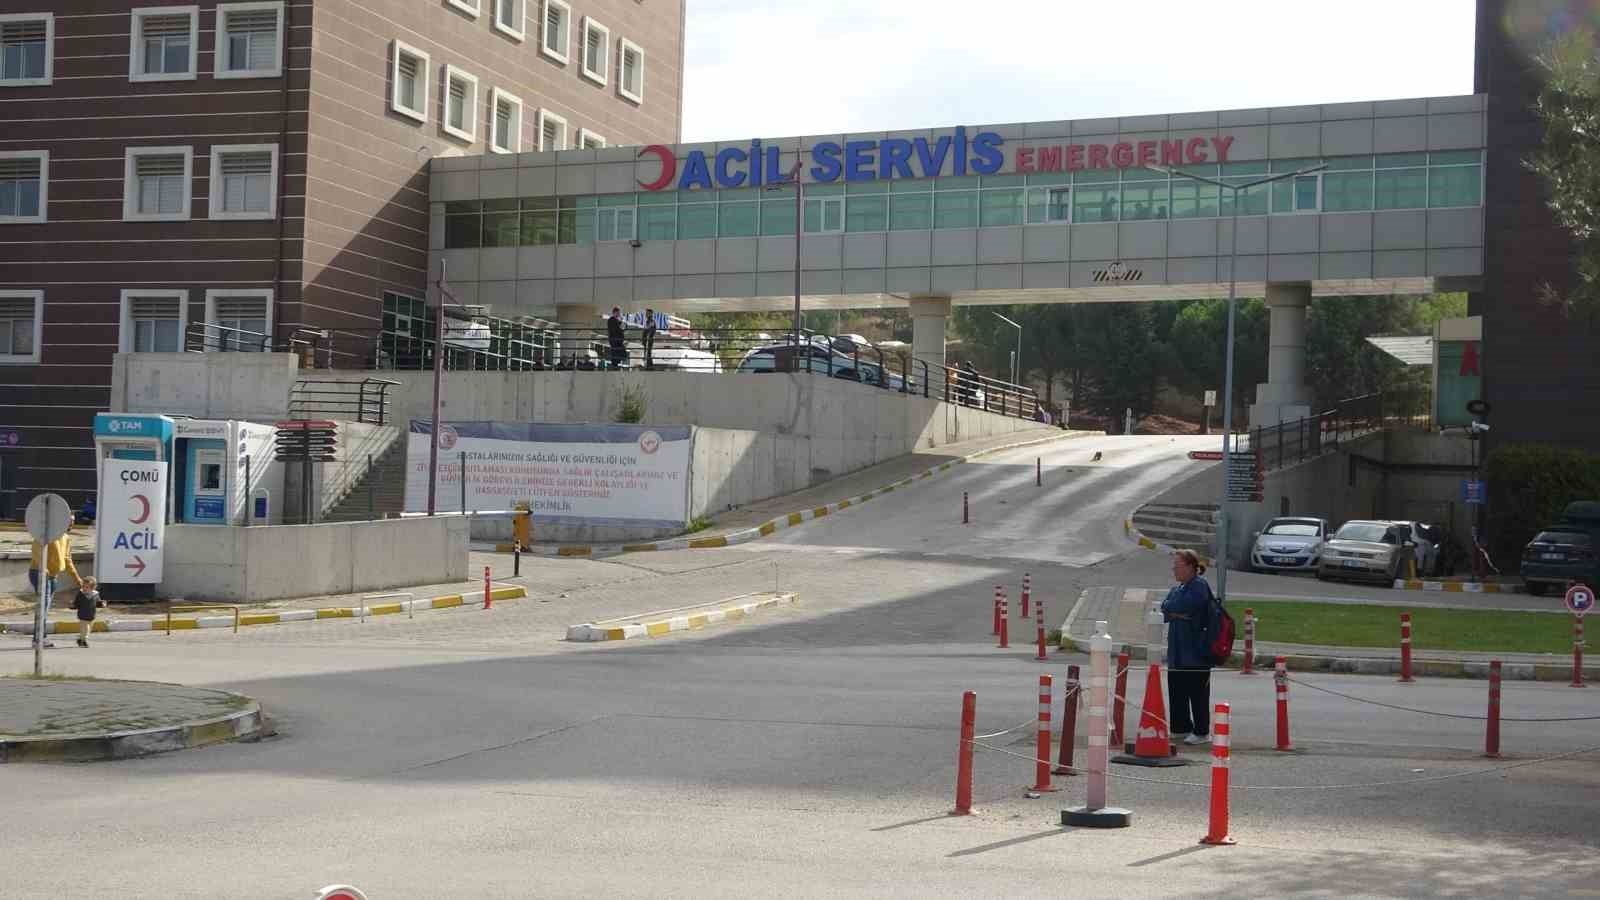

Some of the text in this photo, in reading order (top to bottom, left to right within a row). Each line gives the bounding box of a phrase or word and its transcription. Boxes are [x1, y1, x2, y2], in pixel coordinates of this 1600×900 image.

[678, 125, 1234, 189] ACİL SERVİS EMERGENCY
[120, 421, 142, 430] TAM
[561, 454, 571, 463] VE
[120, 469, 159, 485] ÇOMÜ
[113, 528, 158, 550] ACİL
[1573, 591, 1587, 607] P
